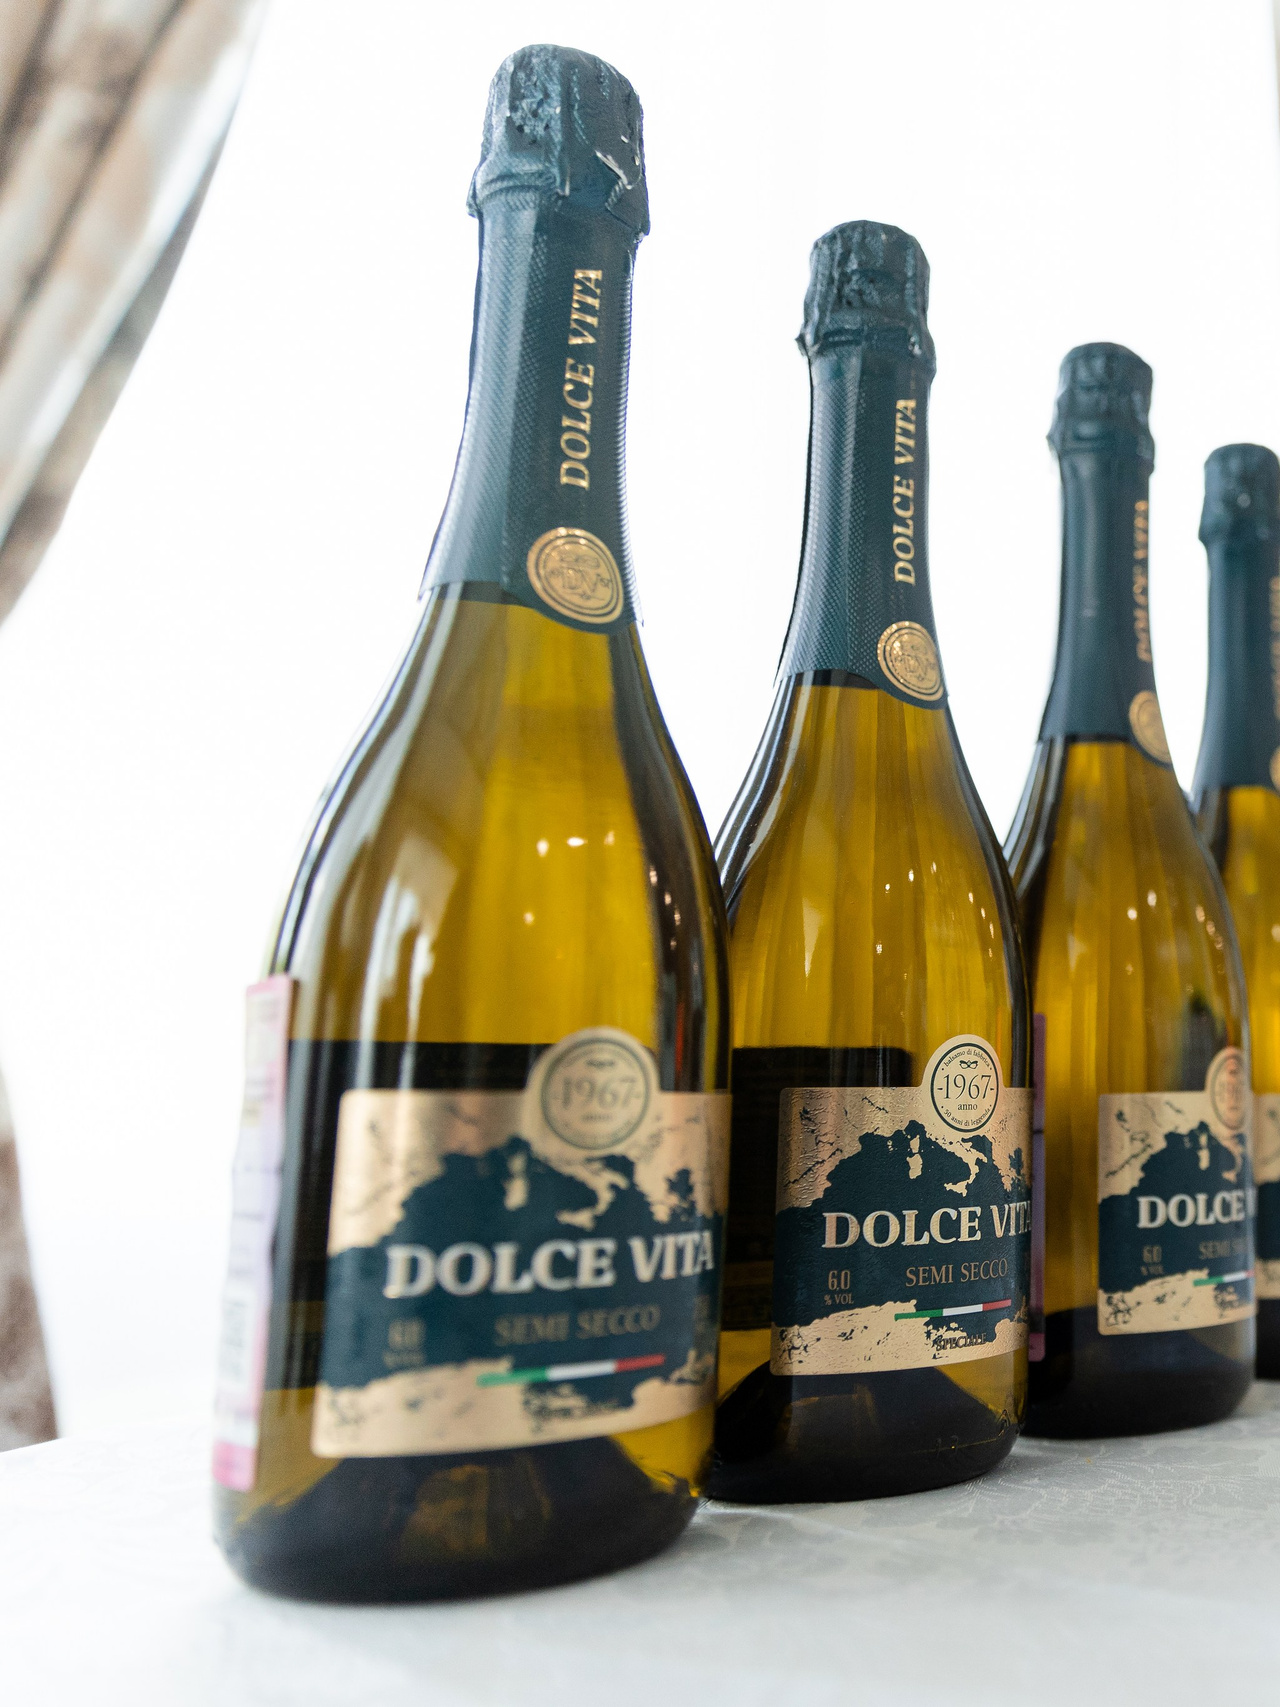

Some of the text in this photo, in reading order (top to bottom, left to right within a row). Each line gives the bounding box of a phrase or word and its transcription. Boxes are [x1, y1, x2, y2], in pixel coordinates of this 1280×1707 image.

[560, 269, 604, 490] DOLCE VITA
[893, 399, 917, 586] DOLCE VITA
[560, 1075, 637, 1111] 1967
[957, 1103, 978, 1111] anno
[821, 1206, 982, 1249] DOLCE
[1136, 1189, 1246, 1229] DOLCE
[383, 1230, 715, 1299] DOLCE VITA
[905, 1258, 1008, 1287] SEMI SECCO
[834, 1292, 855, 1305] VOL
[576, 1304, 661, 1339] SECCO
